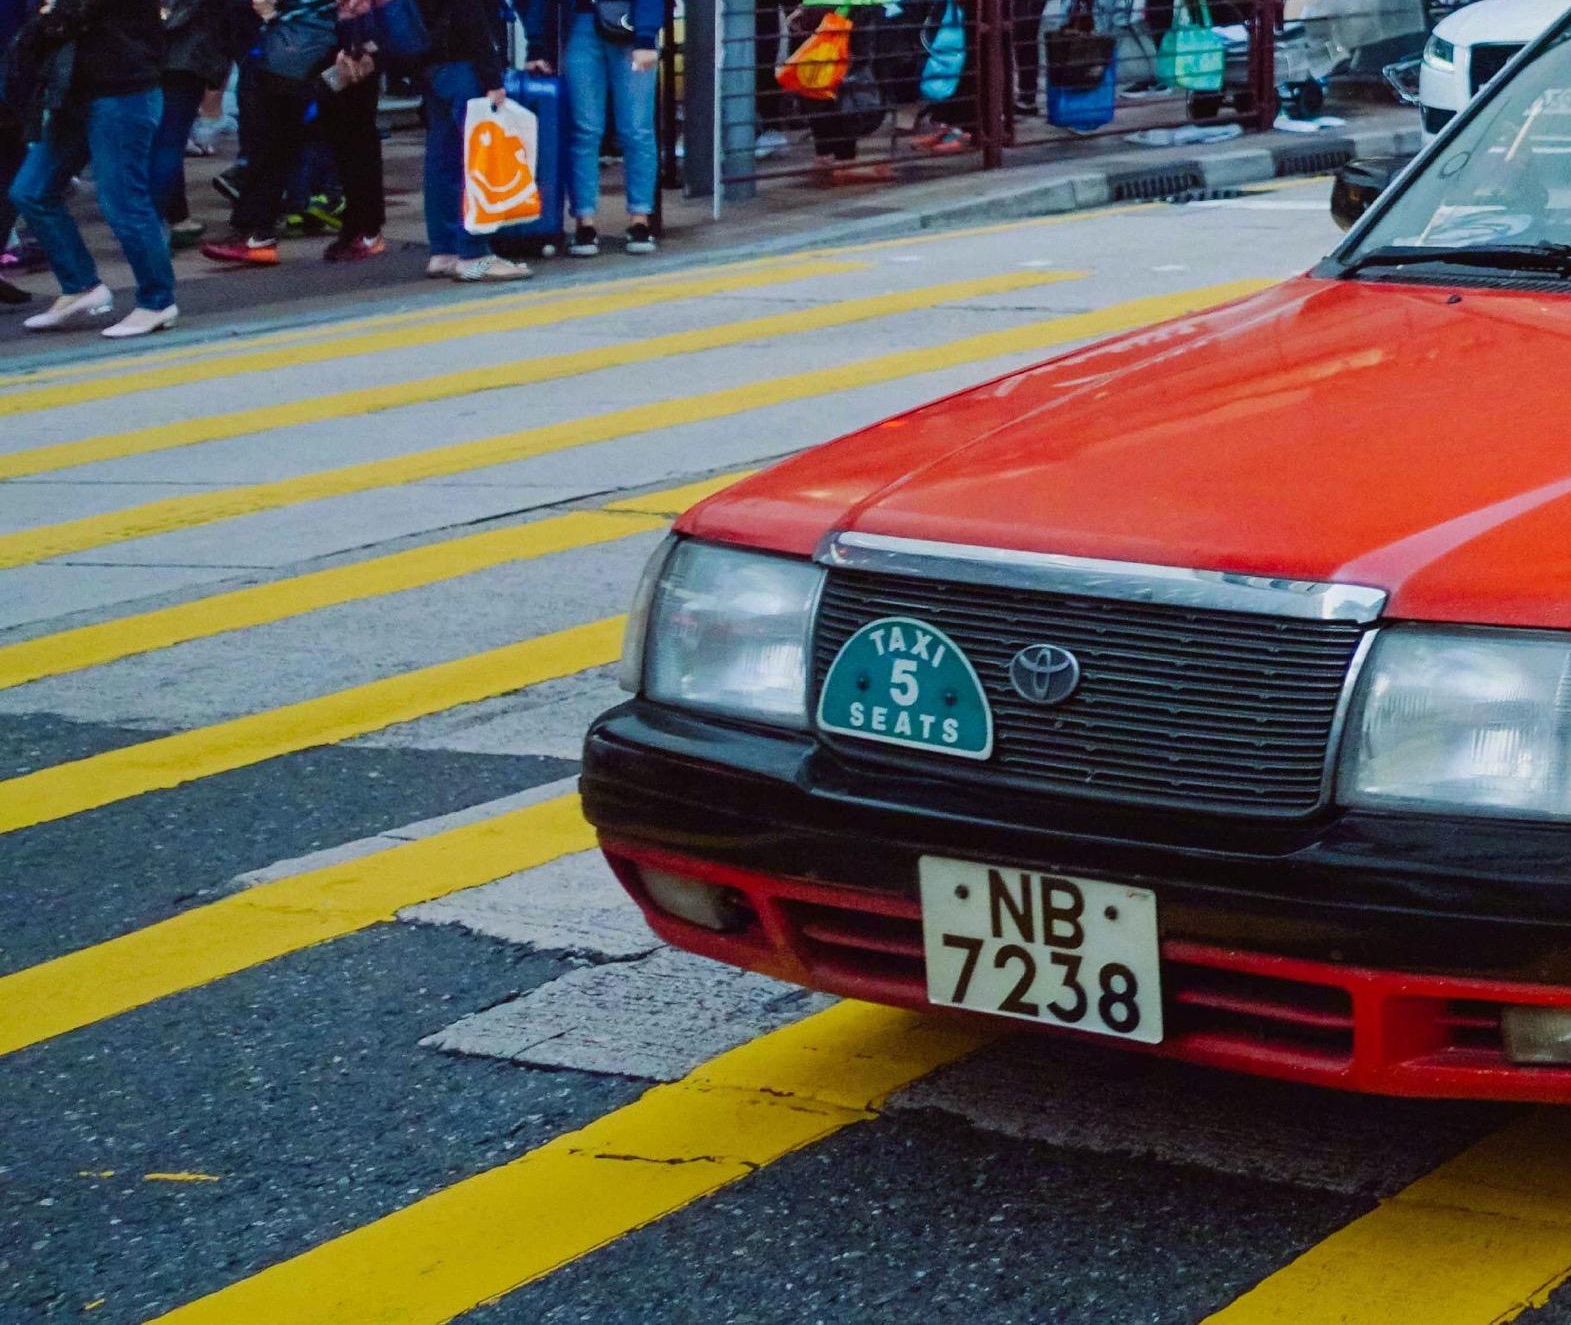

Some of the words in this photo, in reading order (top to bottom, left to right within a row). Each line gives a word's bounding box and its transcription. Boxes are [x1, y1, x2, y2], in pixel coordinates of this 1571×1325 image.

[869, 626, 946, 668] TAXI
[889, 658, 919, 706] 5
[850, 701, 960, 744] SEATS
[988, 869, 1086, 950] NB
[942, 933, 1141, 1034] 7238
